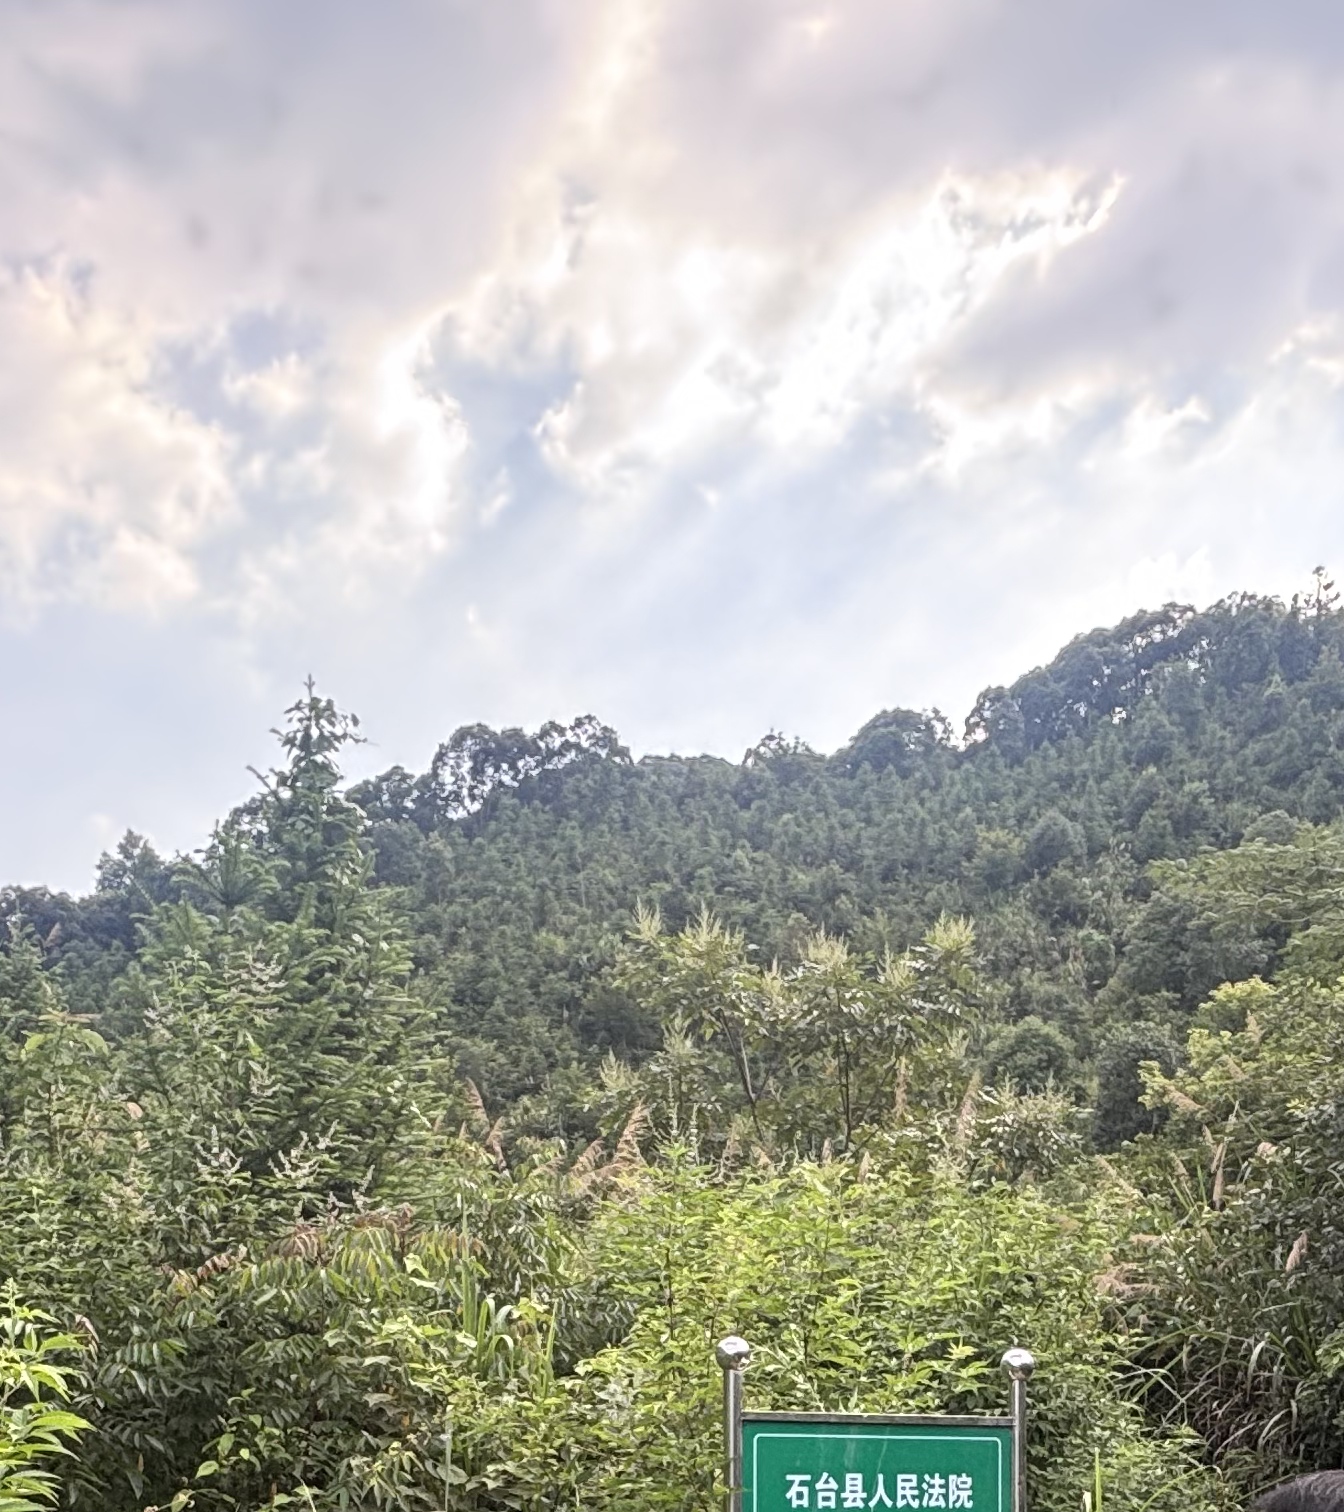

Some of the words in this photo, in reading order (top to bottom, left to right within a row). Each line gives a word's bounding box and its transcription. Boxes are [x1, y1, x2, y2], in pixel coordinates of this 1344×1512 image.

[785, 1473, 974, 1510] 石台县人民法院
